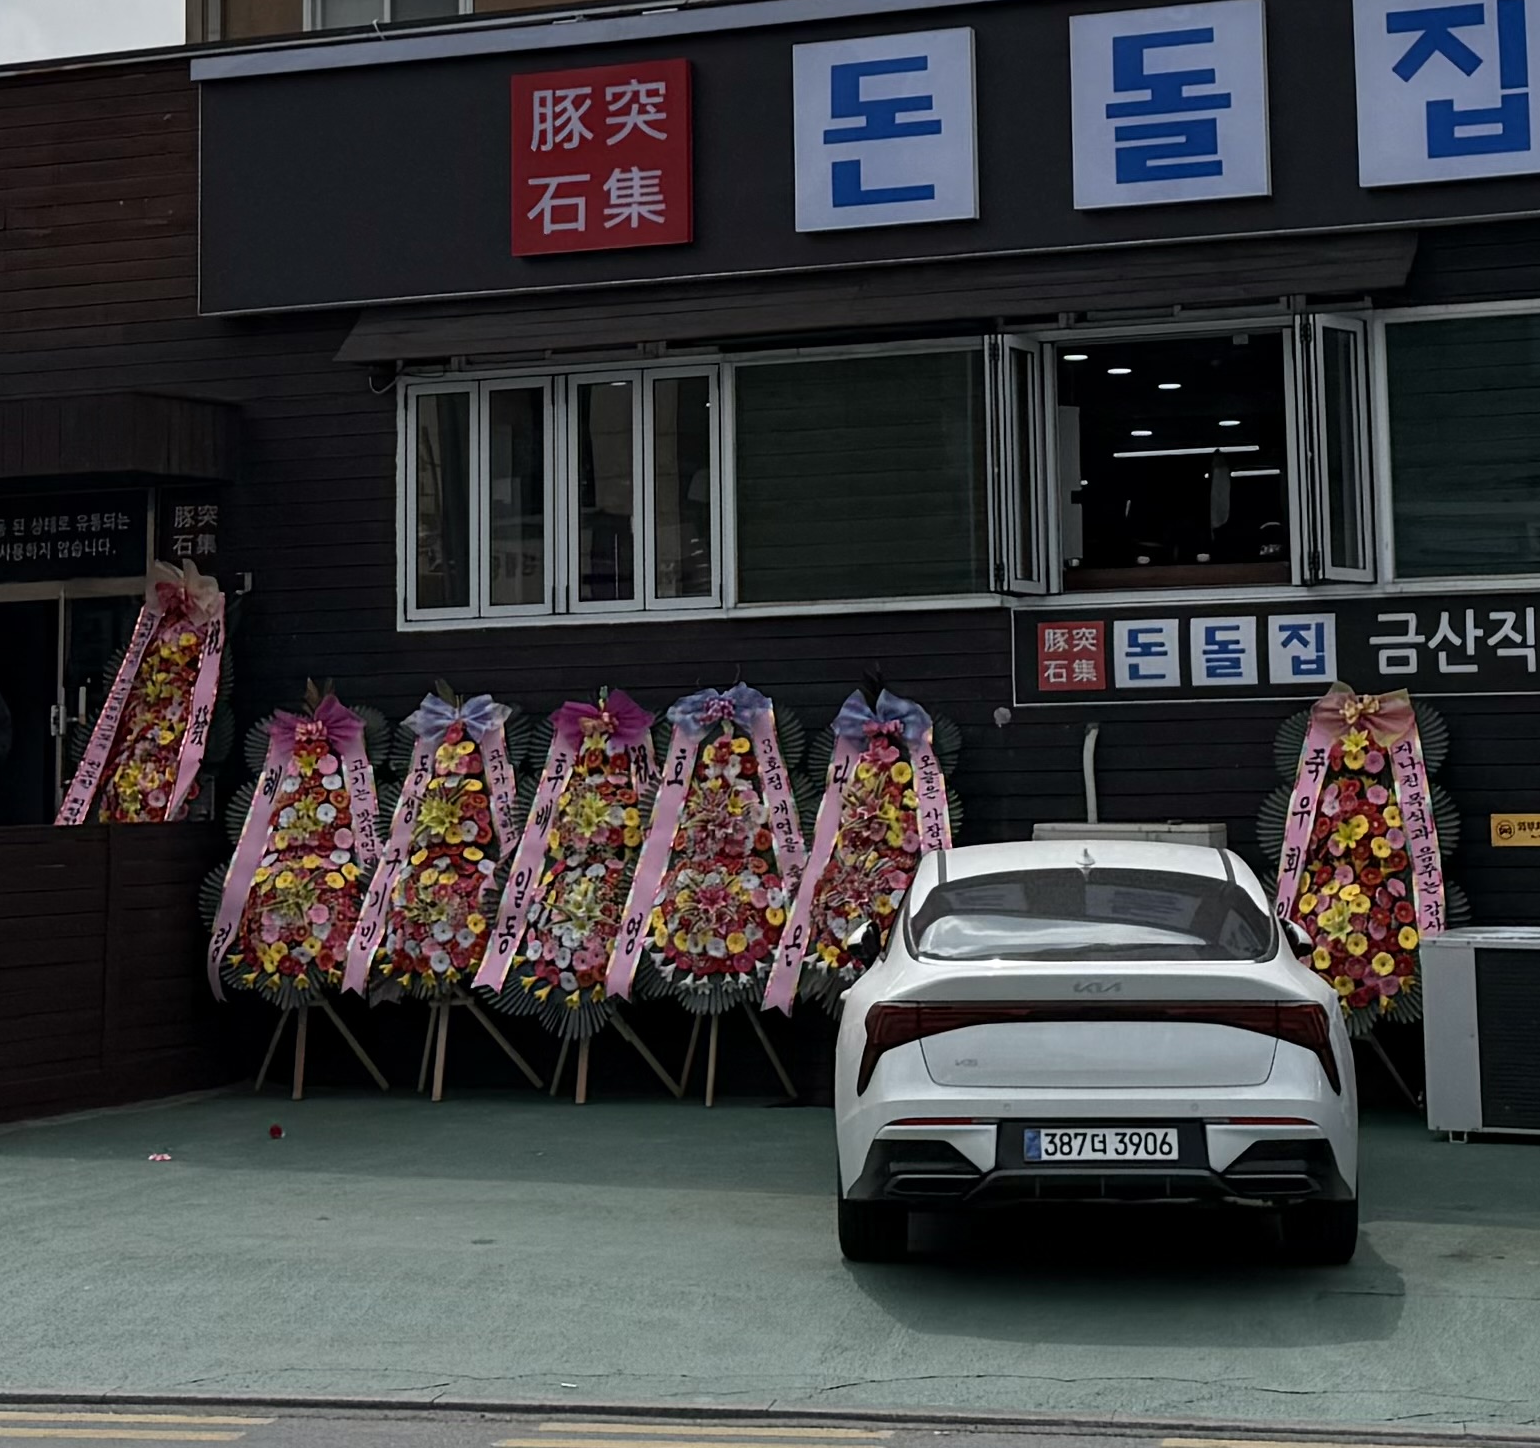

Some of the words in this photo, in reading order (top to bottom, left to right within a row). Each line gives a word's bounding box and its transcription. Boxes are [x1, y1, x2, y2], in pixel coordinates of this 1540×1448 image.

[530, 78, 669, 153] 豚突
[526, 165, 667, 235] 石集
[1044, 626, 1098, 652] 豚突
[1125, 621, 1327, 680] 돈돌집
[1043, 658, 1098, 683] 石集
[1043, 1132, 1107, 1156] 387더
[1114, 1132, 1173, 1156] 3906
